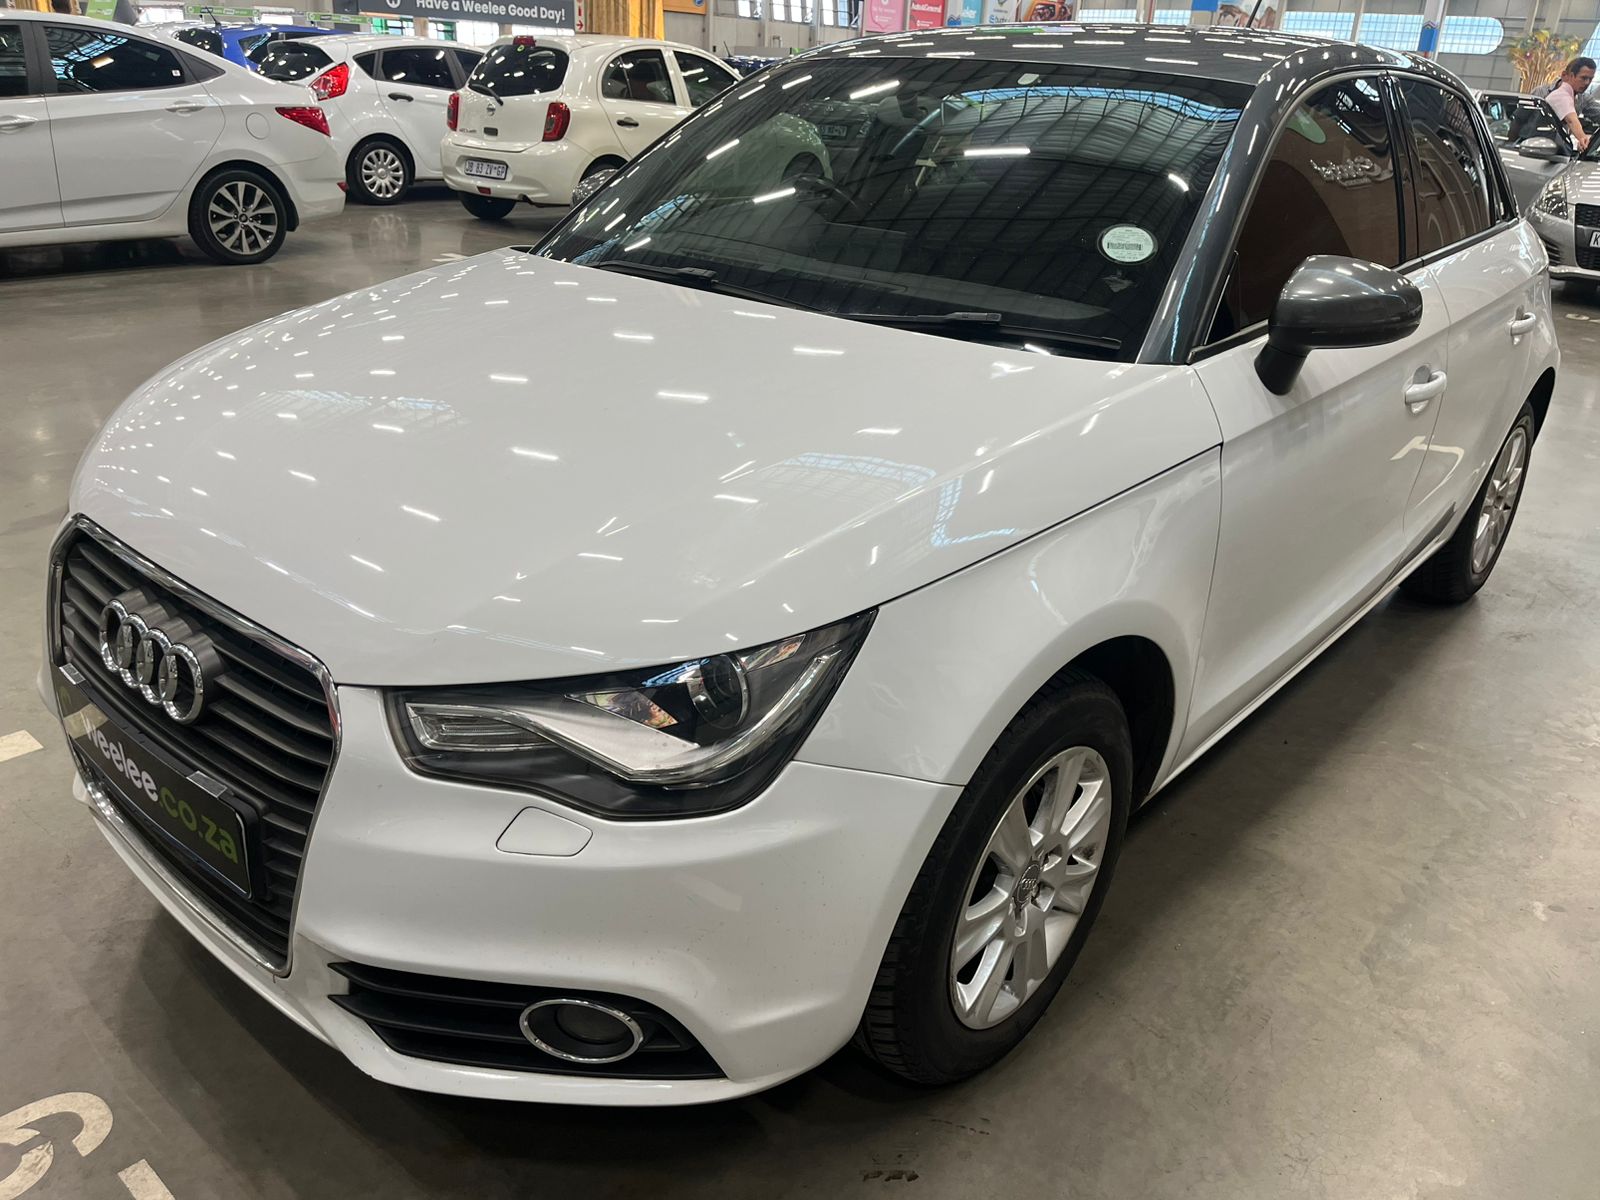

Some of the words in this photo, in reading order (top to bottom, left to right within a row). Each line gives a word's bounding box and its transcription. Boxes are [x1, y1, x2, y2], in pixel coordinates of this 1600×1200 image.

[416, 0, 449, 10] Have
[451, 1, 460, 11] a
[462, 0, 506, 15] Weelee
[508, 4, 538, 18] Good
[540, 6, 566, 24] Day!
